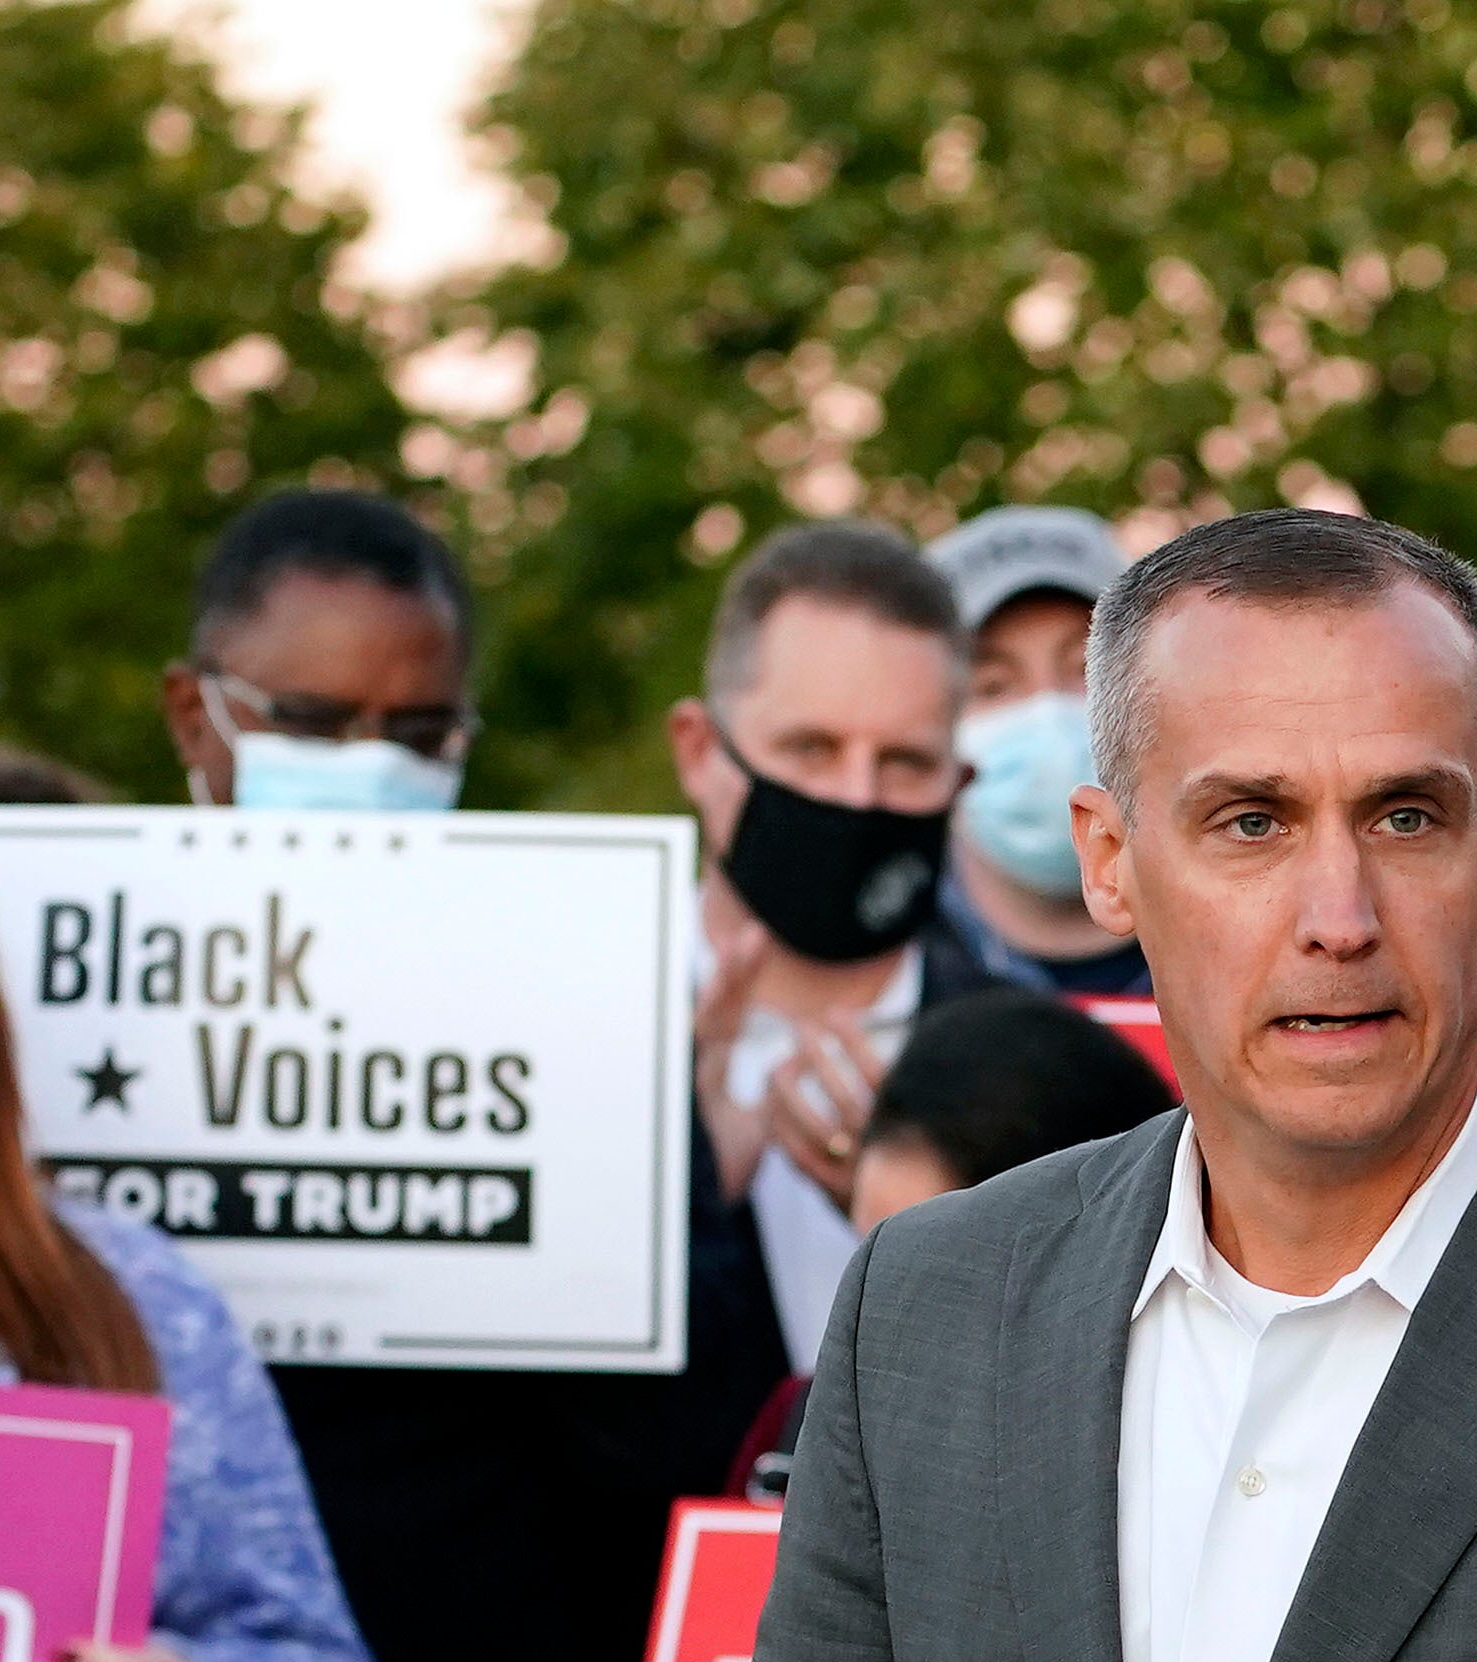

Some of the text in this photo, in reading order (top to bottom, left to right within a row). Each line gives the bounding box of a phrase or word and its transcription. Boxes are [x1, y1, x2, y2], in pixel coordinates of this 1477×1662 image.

[38, 890, 316, 1008] Black
[197, 1017, 533, 1136] Voices
[243, 1169, 523, 1234] TRUMP
